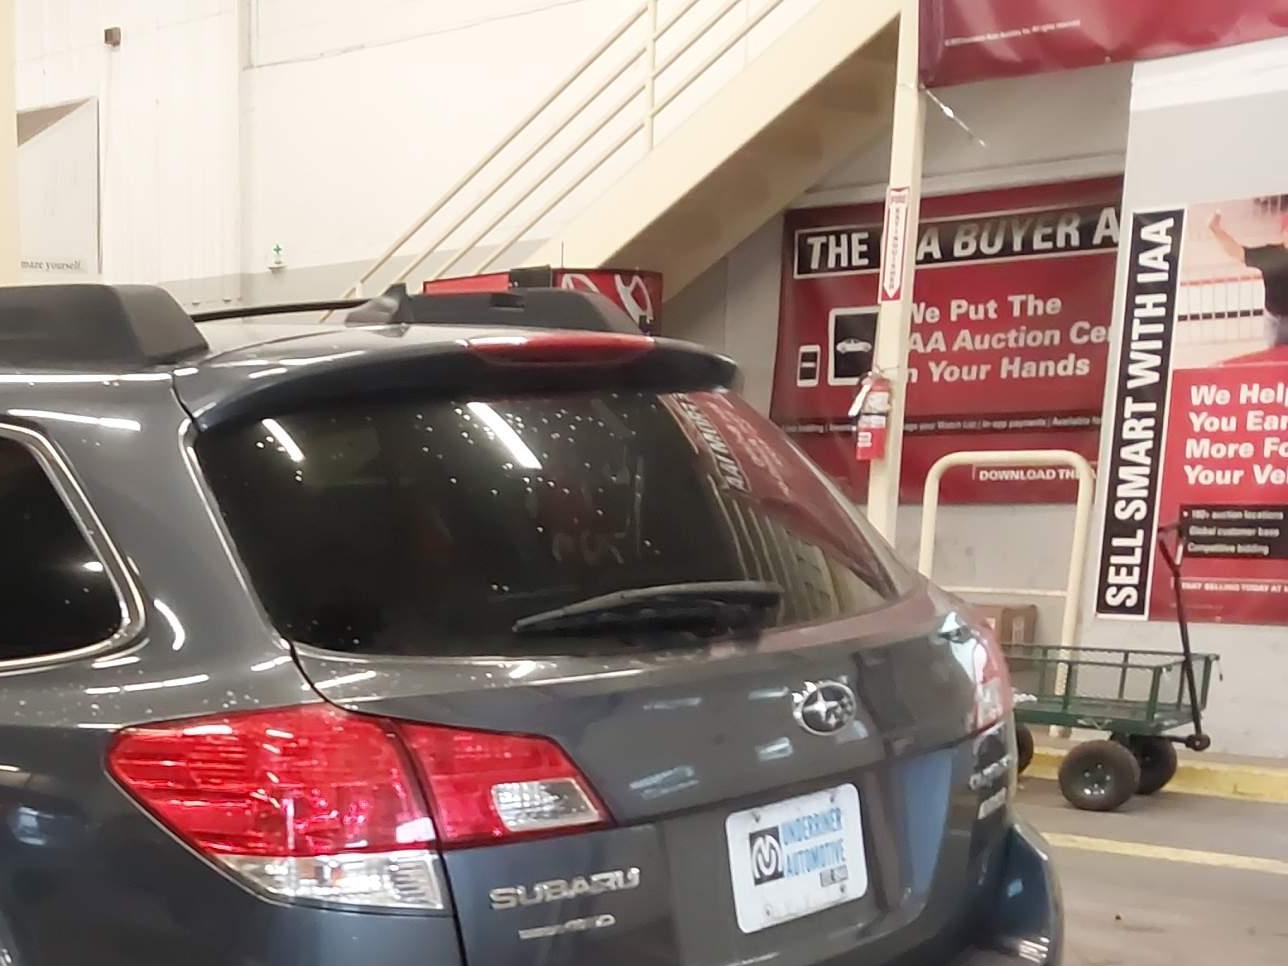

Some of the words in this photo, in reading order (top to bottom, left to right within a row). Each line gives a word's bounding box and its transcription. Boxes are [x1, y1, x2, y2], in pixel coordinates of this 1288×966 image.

[807, 232, 869, 269] THE
[952, 212, 1081, 258] BUYER
[1137, 217, 1174, 283] IAA
[950, 299, 998, 321] Put
[1007, 294, 1062, 317] The
[909, 331, 947, 353] AA
[952, 326, 1060, 351] Auction
[1127, 293, 1167, 389] WITH
[928, 360, 991, 384] Your
[1000, 353, 1090, 379] Hands
[1191, 384, 1231, 406] We
[1240, 382, 1288, 408] Hel
[1189, 411, 1237, 432] You
[1114, 396, 1157, 521] SMART
[1186, 438, 1254, 459] More
[979, 468, 1056, 482] DOWNLOAD
[1059, 468, 1078, 481] TH
[1184, 464, 1244, 485] Your
[1253, 463, 1288, 485] Ve
[1105, 529, 1144, 608] SELL
[489, 866, 641, 911] SUBARU
